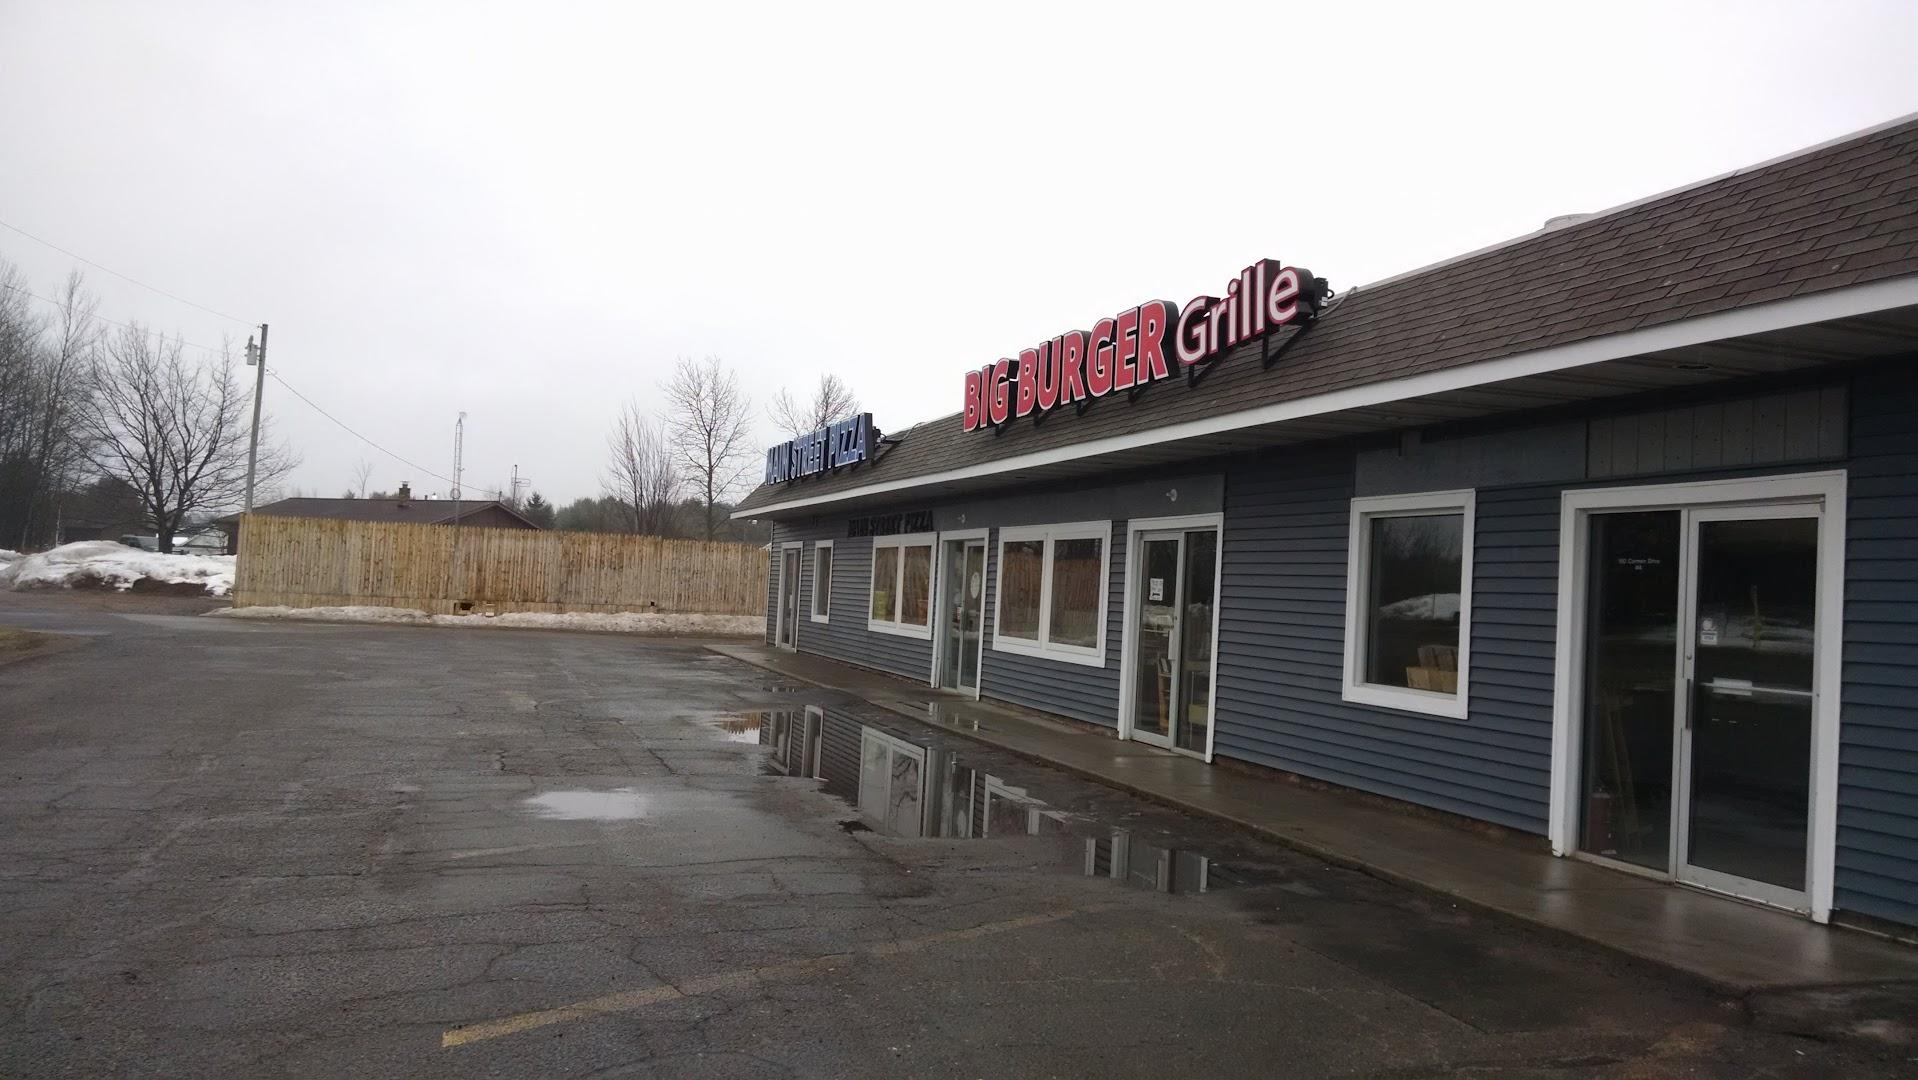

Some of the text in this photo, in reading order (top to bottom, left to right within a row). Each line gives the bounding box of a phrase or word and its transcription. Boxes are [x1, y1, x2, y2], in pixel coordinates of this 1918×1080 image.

[963, 258, 1301, 432] BIG BURGER Grille
[765, 412, 867, 486] MAIN STREET PIZZA
[904, 510, 935, 533] PIZZA
